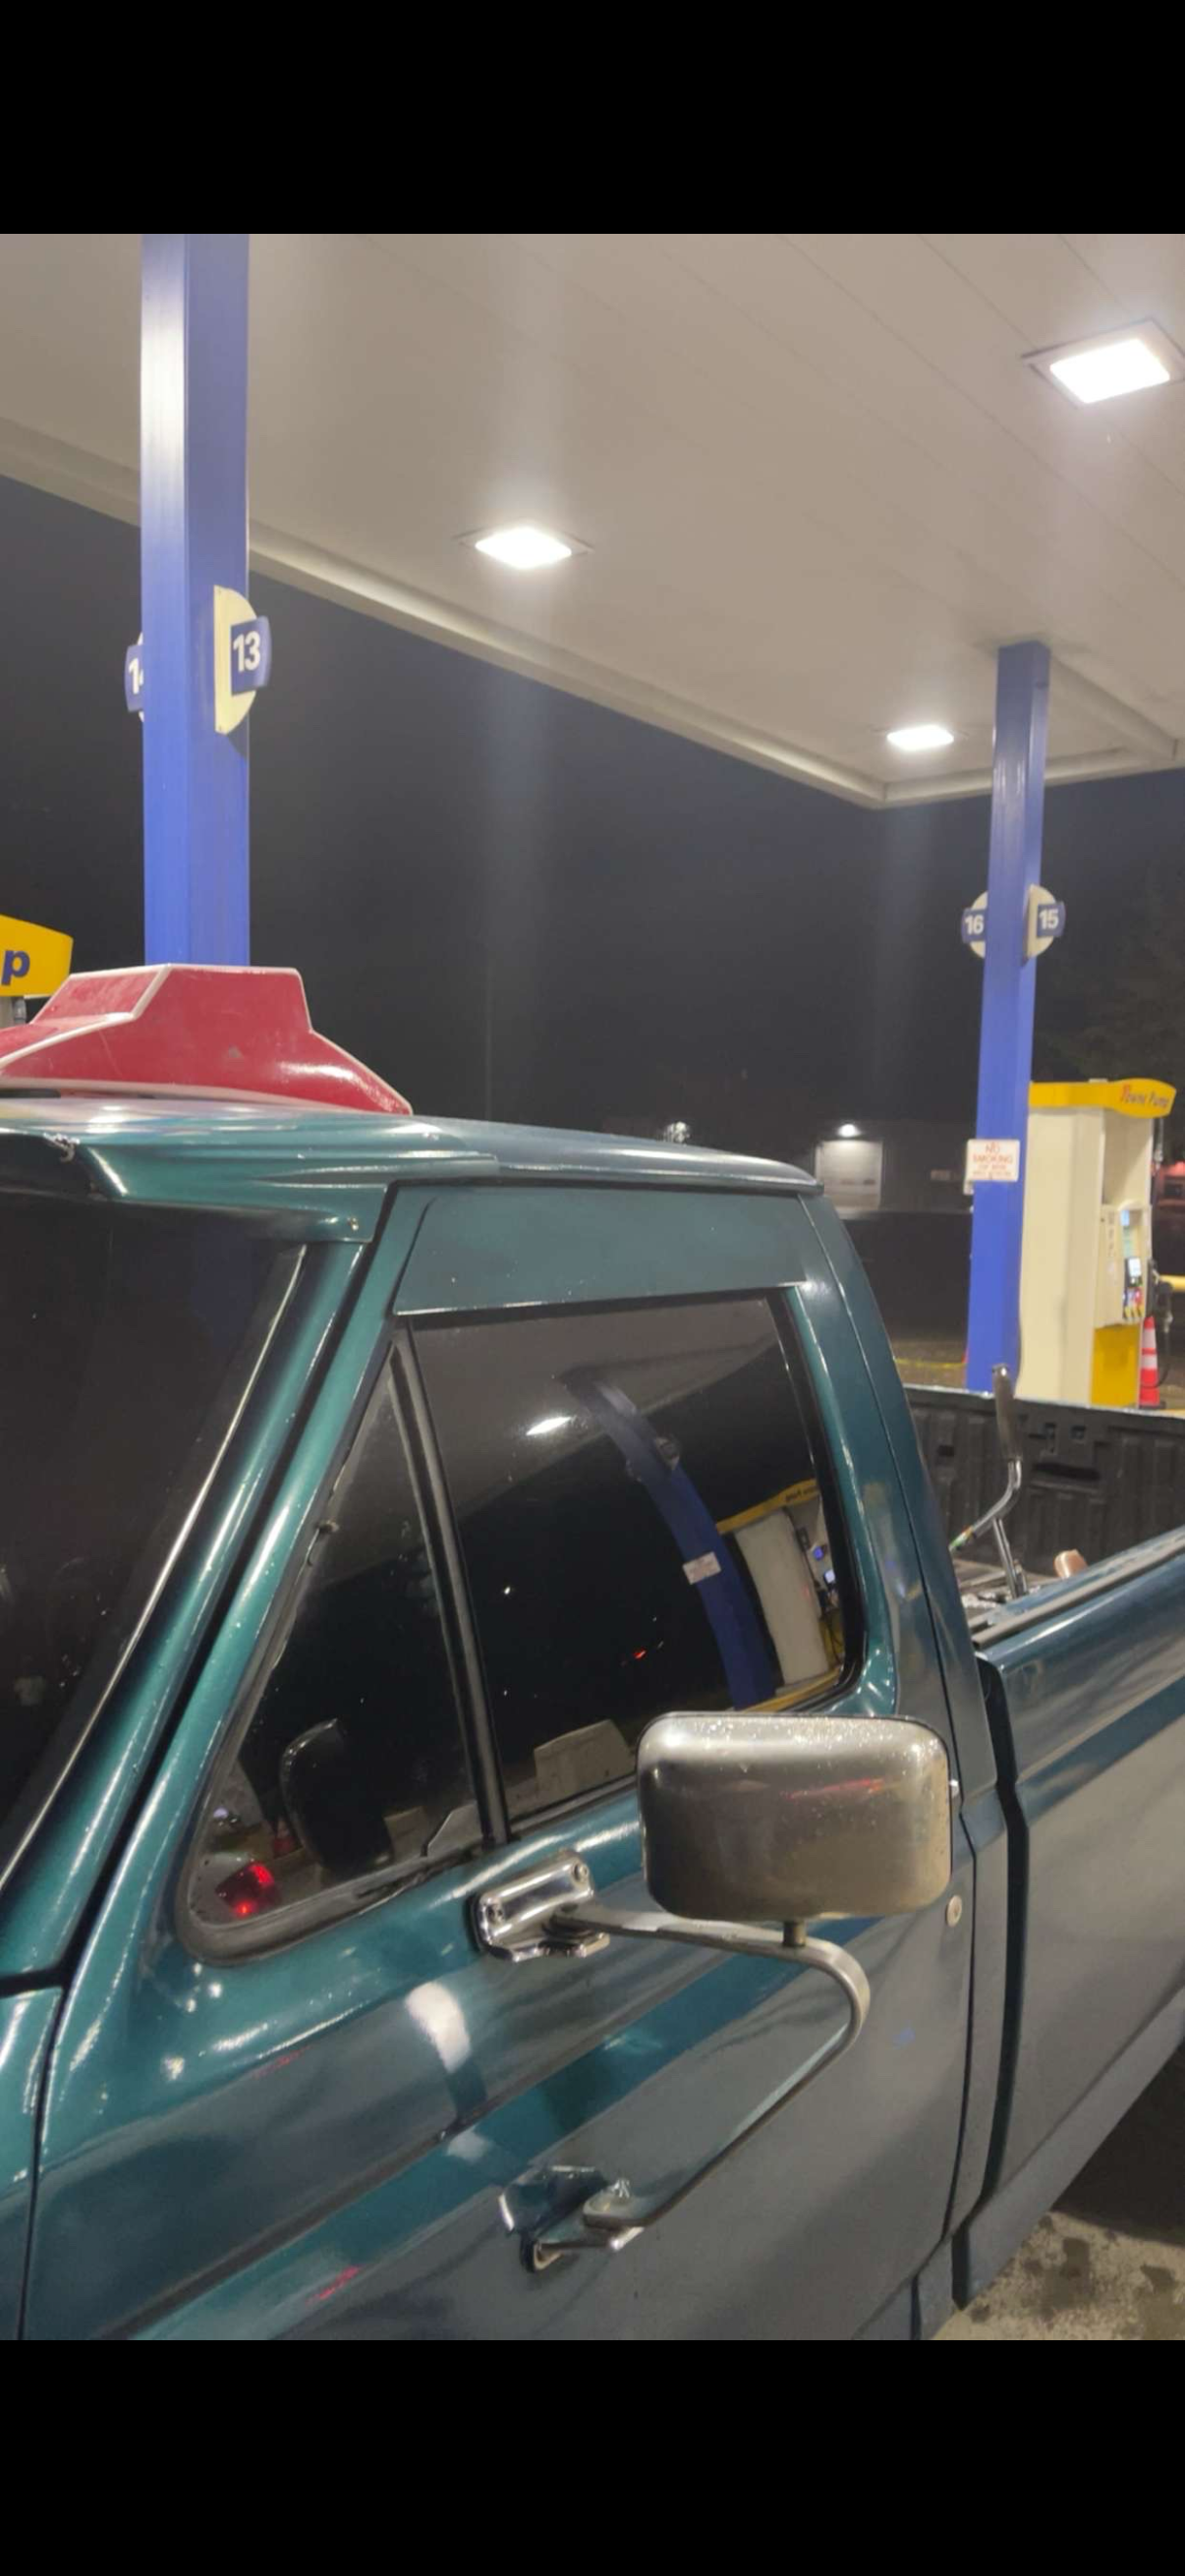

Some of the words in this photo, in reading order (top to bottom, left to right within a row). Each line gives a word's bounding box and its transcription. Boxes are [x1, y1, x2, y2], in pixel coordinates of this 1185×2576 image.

[233, 631, 260, 672] 13
[129, 657, 143, 695] 1
[964, 914, 985, 935] 16
[1039, 908, 1059, 929] 15
[973, 1153, 1013, 1164] SMOKING
[985, 1143, 1000, 1153] NO
